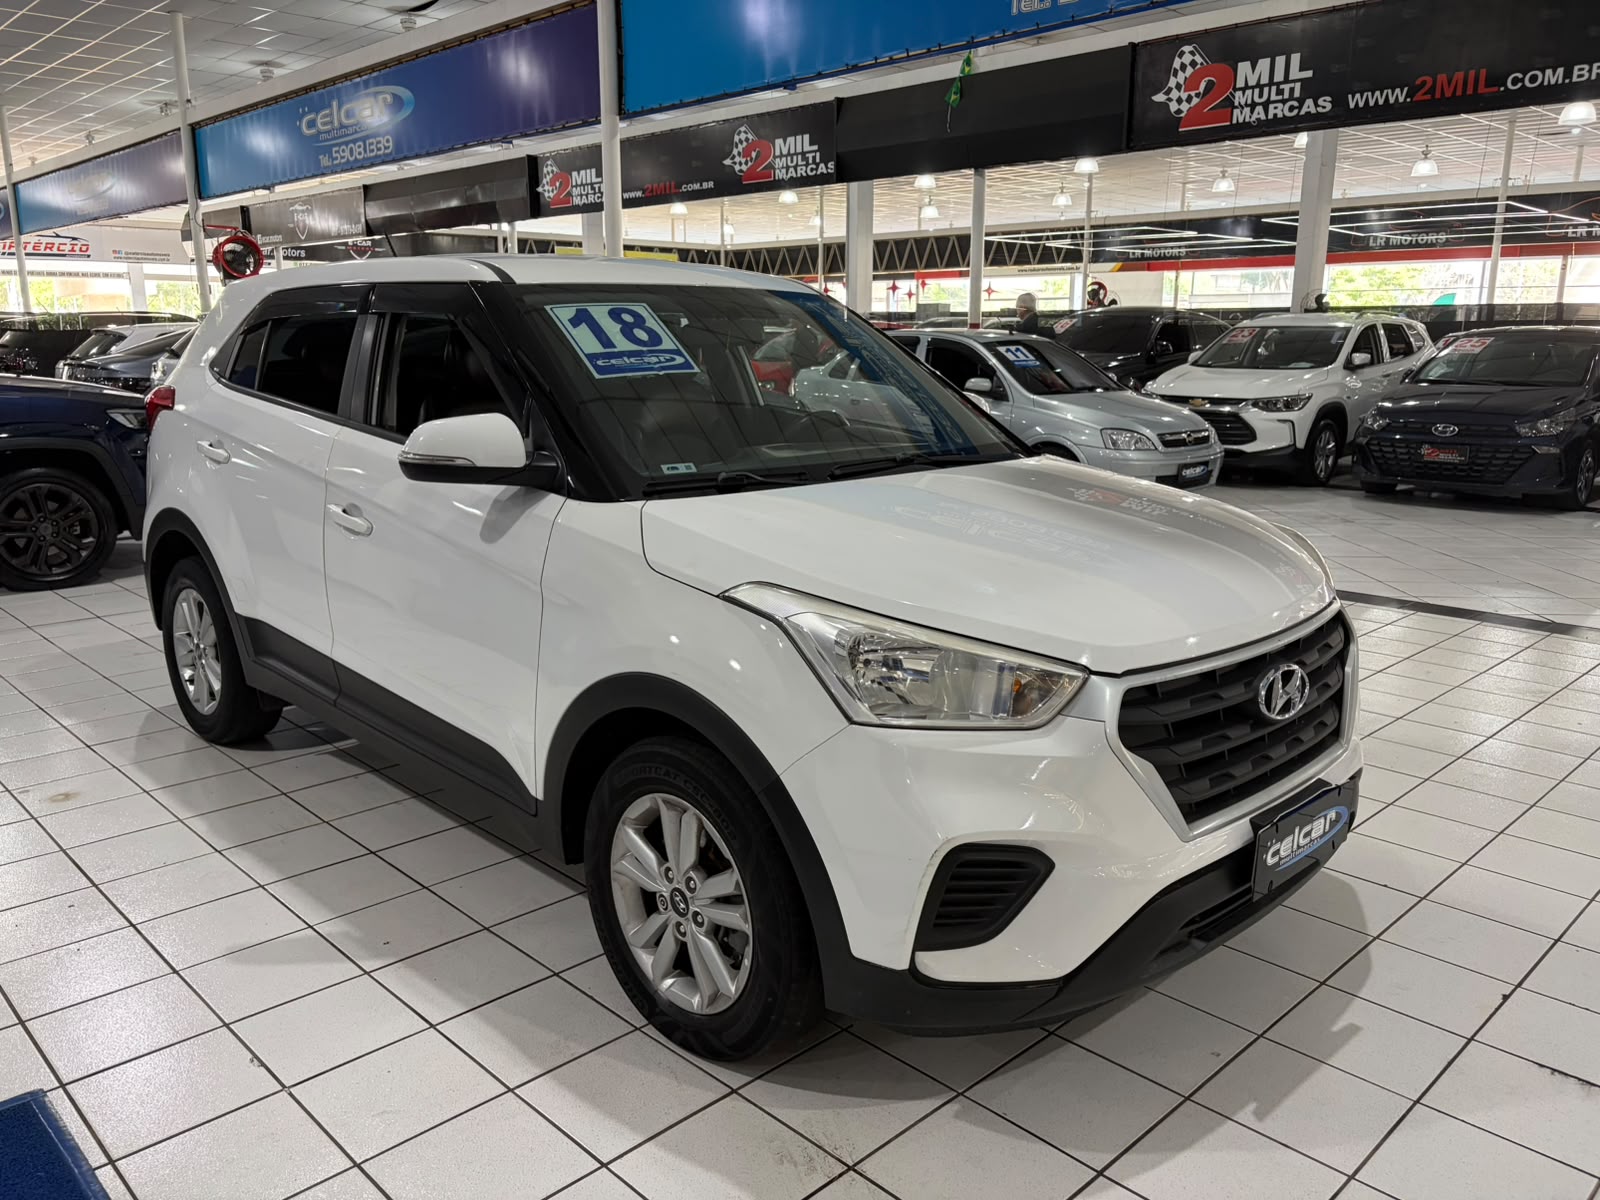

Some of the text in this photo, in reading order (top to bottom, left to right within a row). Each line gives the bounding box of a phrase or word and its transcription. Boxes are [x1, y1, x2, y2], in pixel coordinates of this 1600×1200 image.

[1235, 52, 1314, 89] MIL
[1178, 63, 1235, 132] 2
[1233, 82, 1302, 106] MULTI
[302, 93, 394, 136] celcar
[1232, 96, 1333, 125] MARCAS
[332, 135, 393, 165] 5908.1339
[775, 133, 819, 157] MIL
[742, 138, 774, 184] 2
[775, 152, 820, 168] MULTI
[775, 161, 835, 180] MARCAS
[571, 168, 602, 185] MIL
[549, 172, 572, 208] 2
[572, 193, 604, 206] MARC
[1369, 232, 1447, 247] LR MOTORS
[1144, 247, 1187, 258] MOTORS
[568, 307, 663, 350] 18
[596, 355, 671, 367] celcar
[1005, 347, 1031, 359] 11
[1266, 810, 1336, 866] celcar
